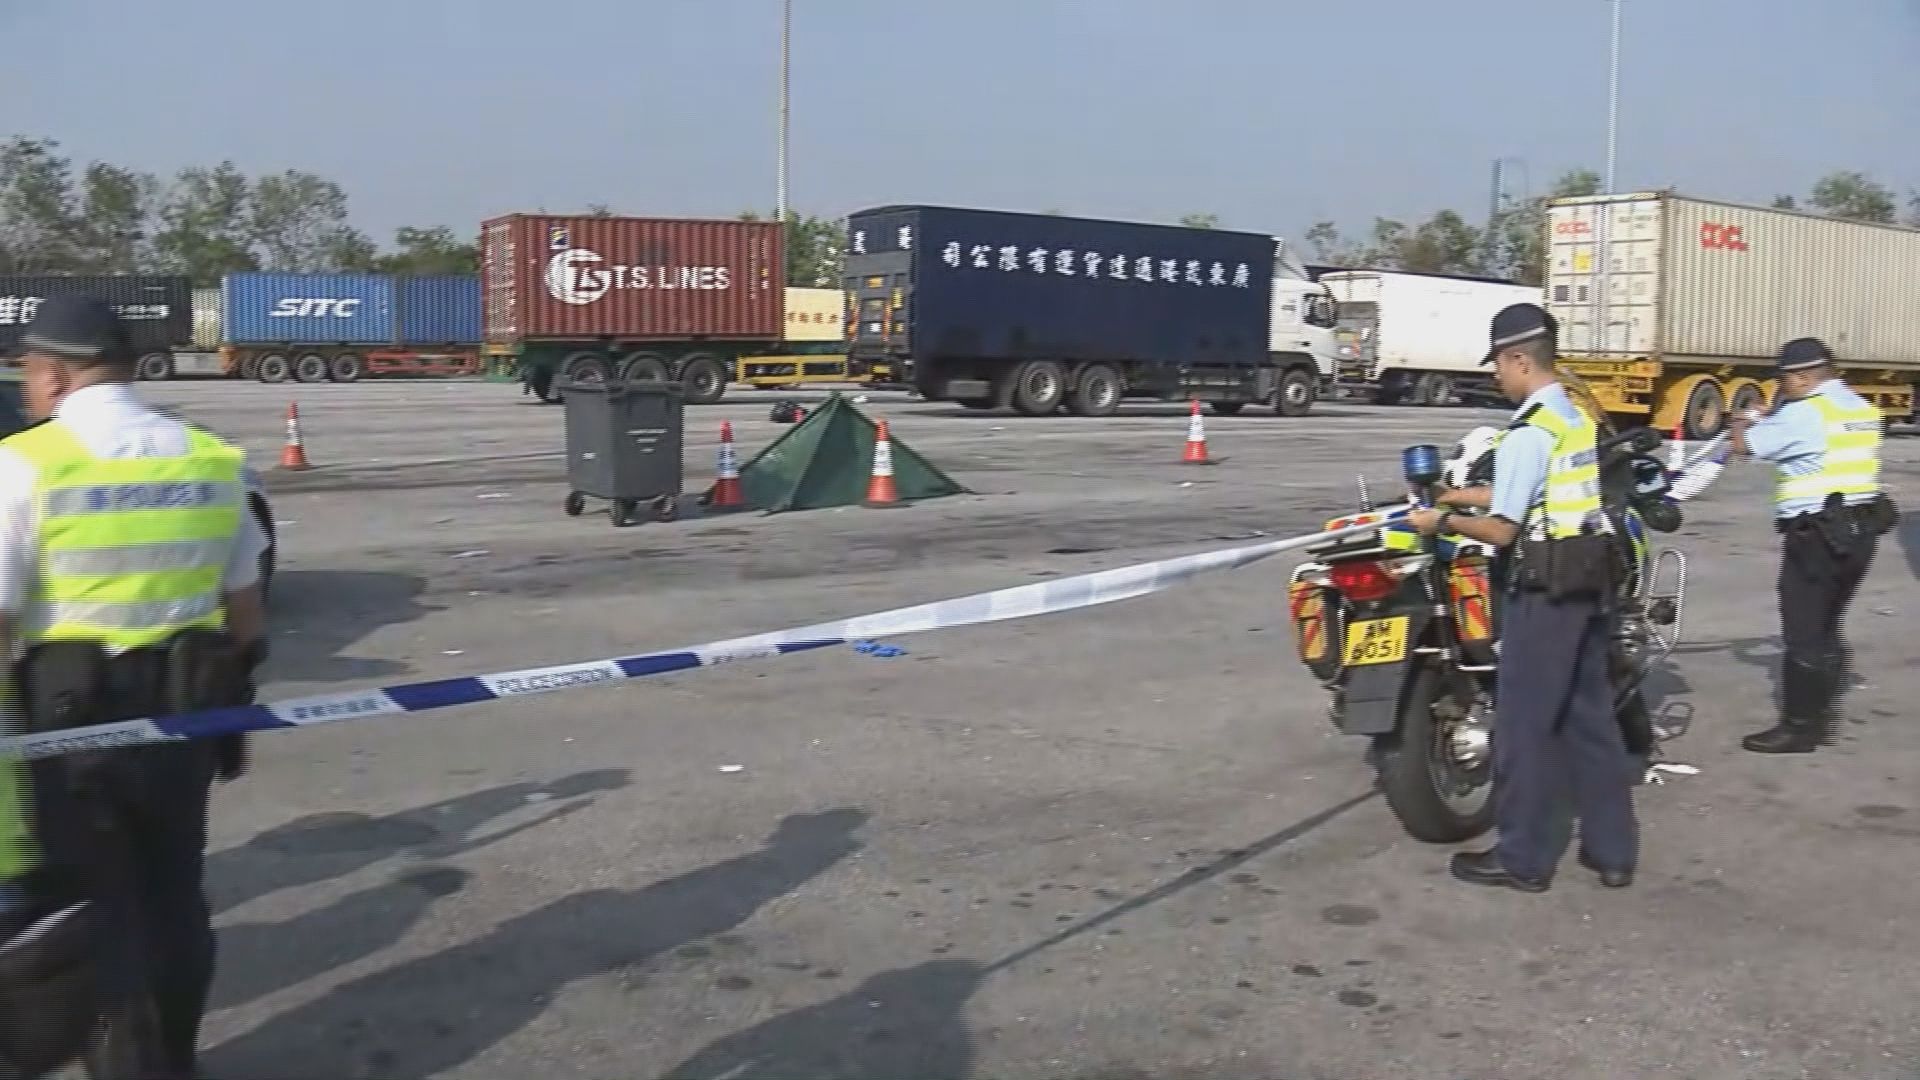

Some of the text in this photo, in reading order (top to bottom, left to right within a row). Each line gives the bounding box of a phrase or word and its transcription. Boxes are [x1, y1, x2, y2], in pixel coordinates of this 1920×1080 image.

[612, 265, 731, 290] T.S. LINES
[269, 298, 361, 318] SITC
[1351, 638, 1402, 661] 6051
